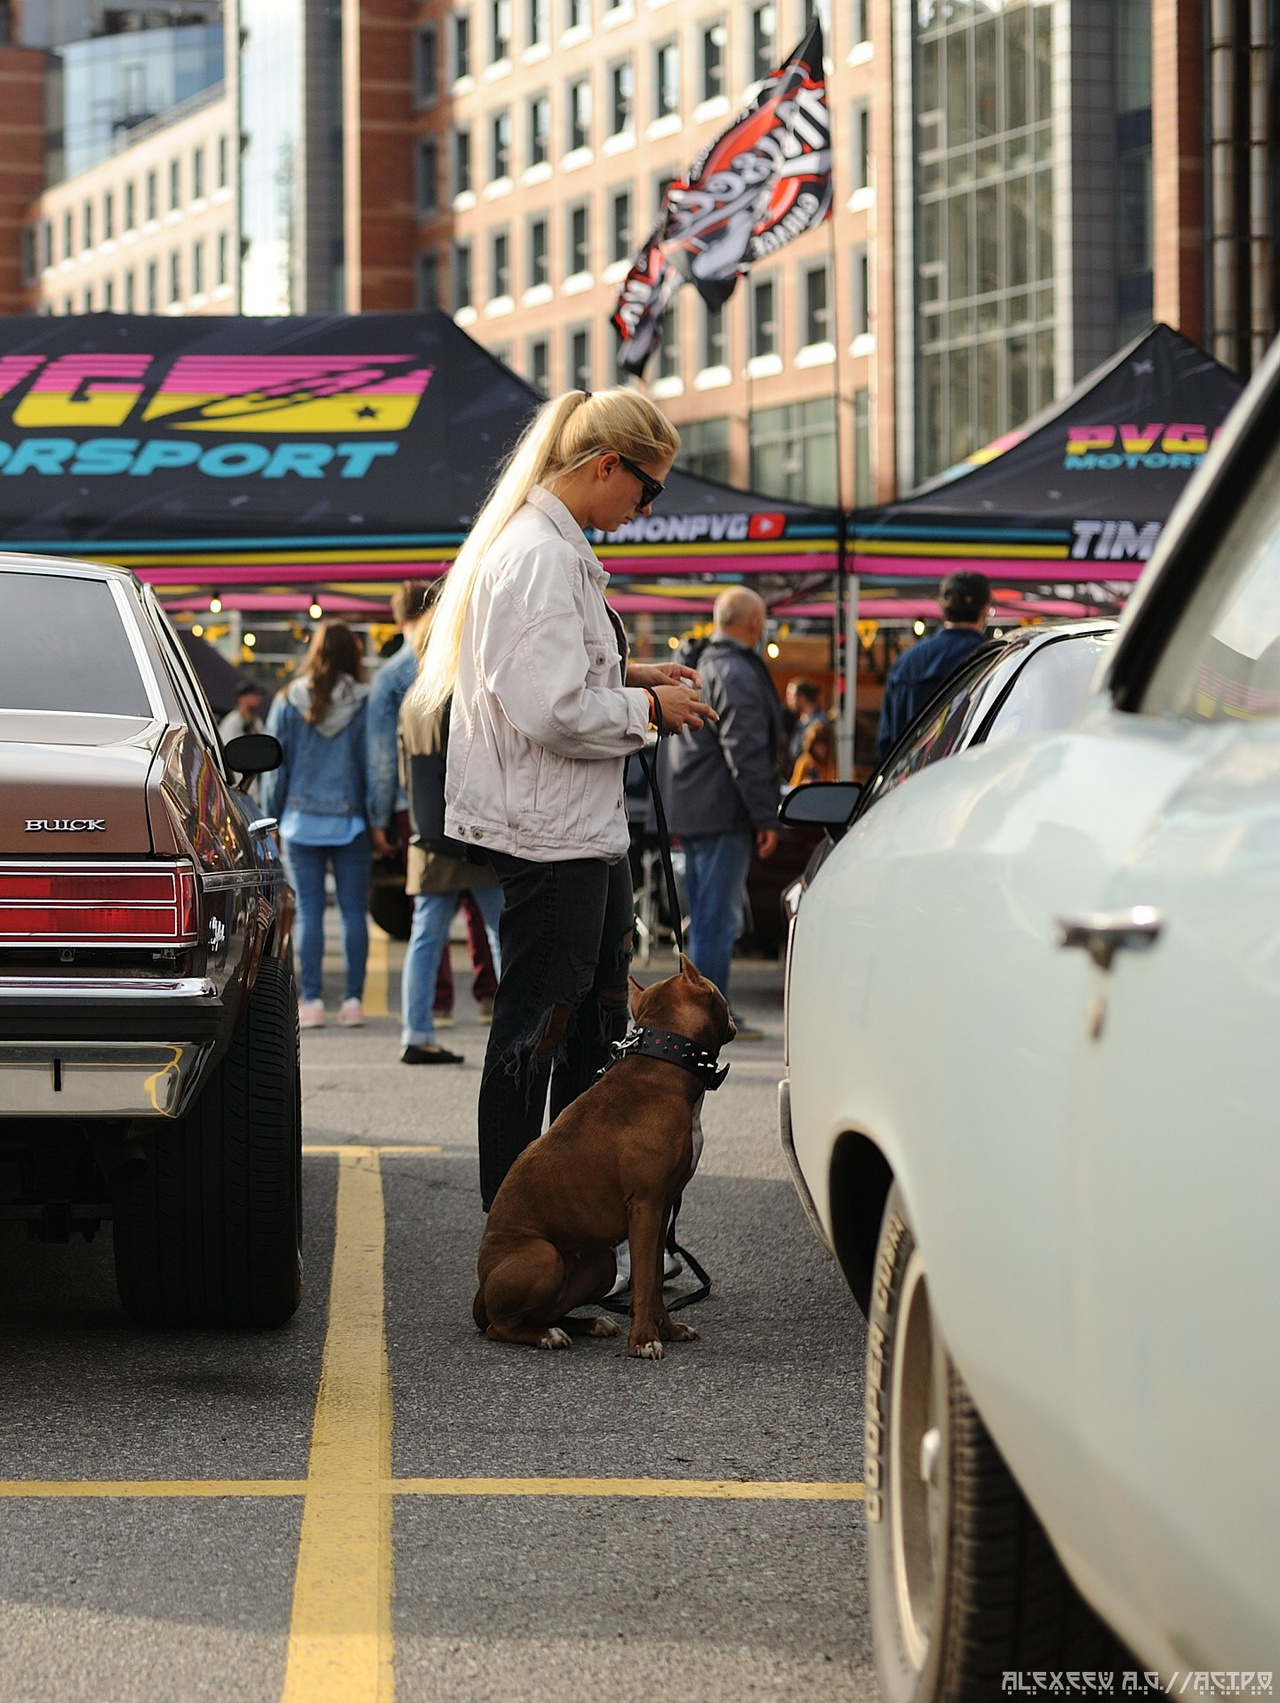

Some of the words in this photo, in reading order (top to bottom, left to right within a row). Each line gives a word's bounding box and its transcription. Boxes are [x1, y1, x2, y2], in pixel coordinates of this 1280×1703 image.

[1066, 422, 1209, 456] PVG
[24, 818, 107, 832] BUICK
[865, 1320, 886, 1524] COOPER
